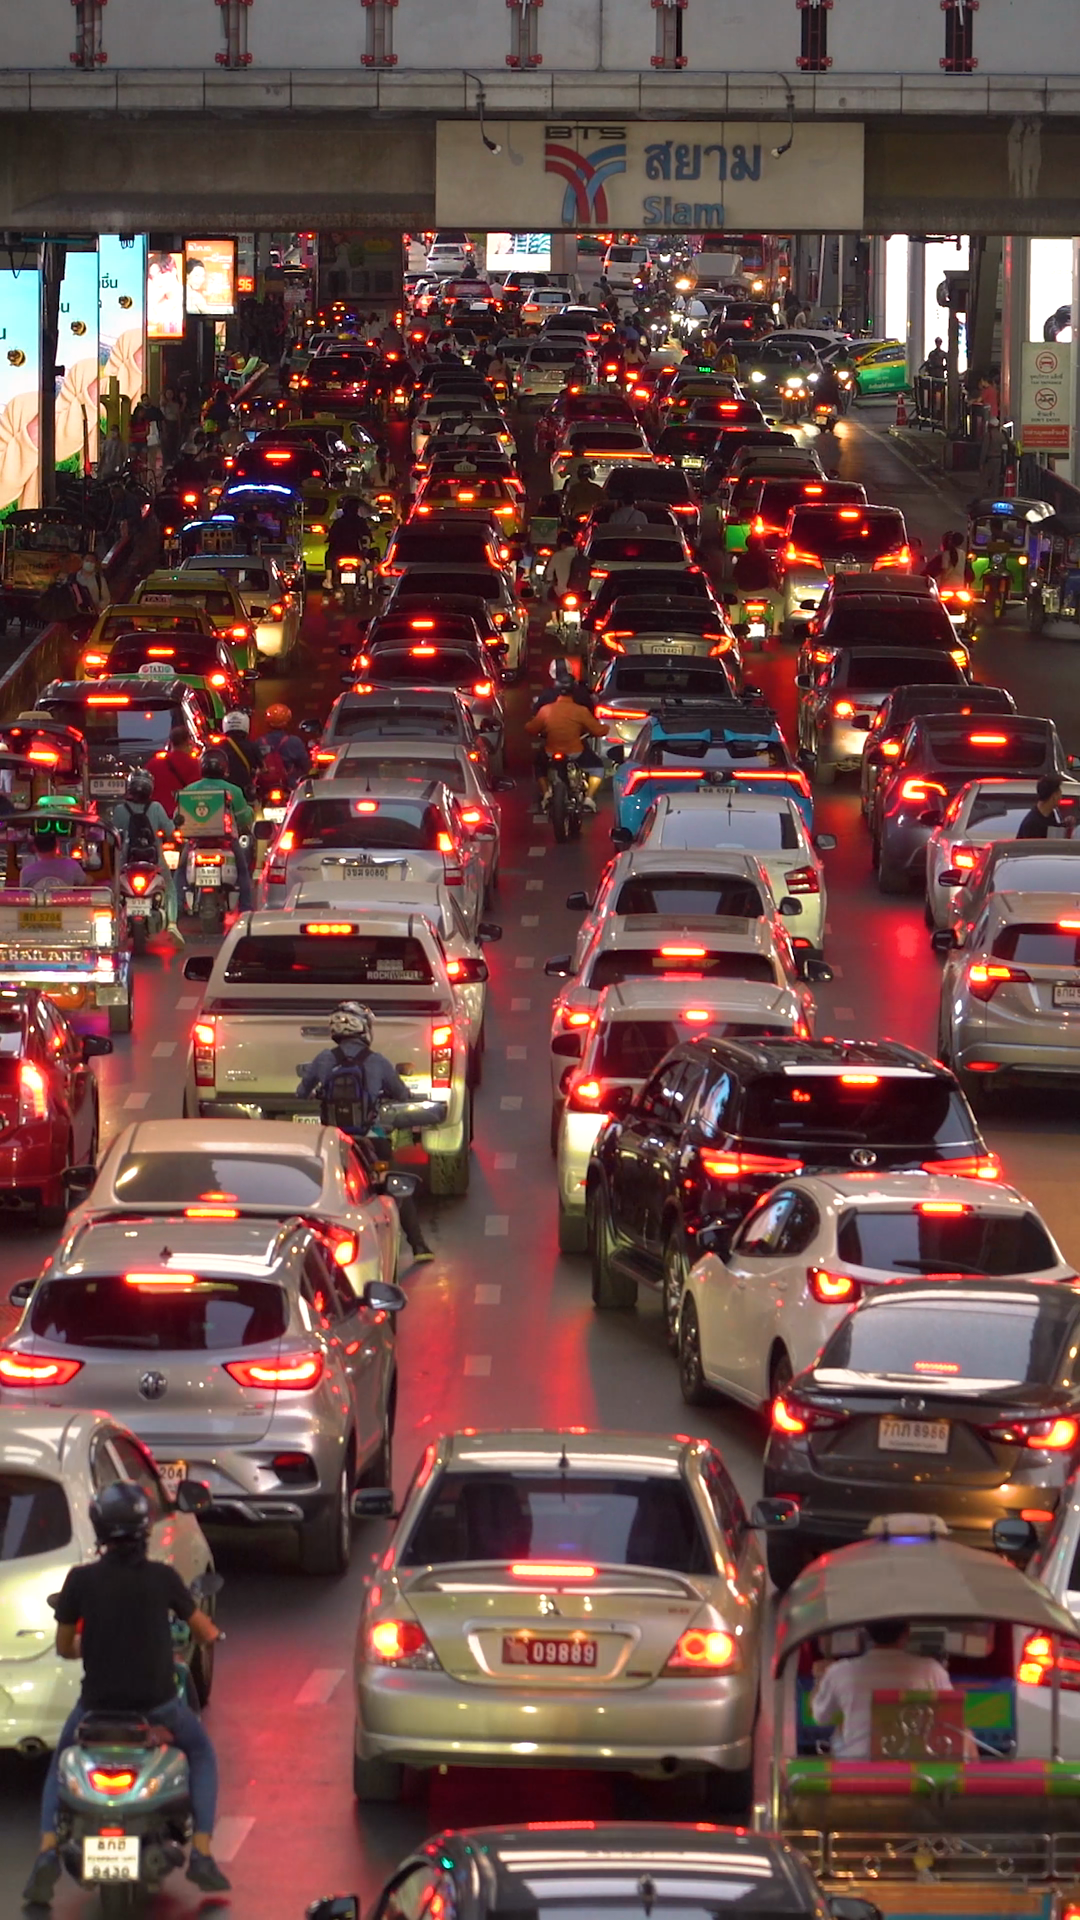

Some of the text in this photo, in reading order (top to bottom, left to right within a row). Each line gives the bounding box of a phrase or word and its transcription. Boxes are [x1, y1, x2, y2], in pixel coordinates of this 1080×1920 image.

[545, 126, 627, 140] BTS
[643, 140, 761, 182] สยาม
[642, 196, 725, 226] Siam
[0, 949, 84, 961] THAILAND
[533, 1641, 594, 1664] 09889
